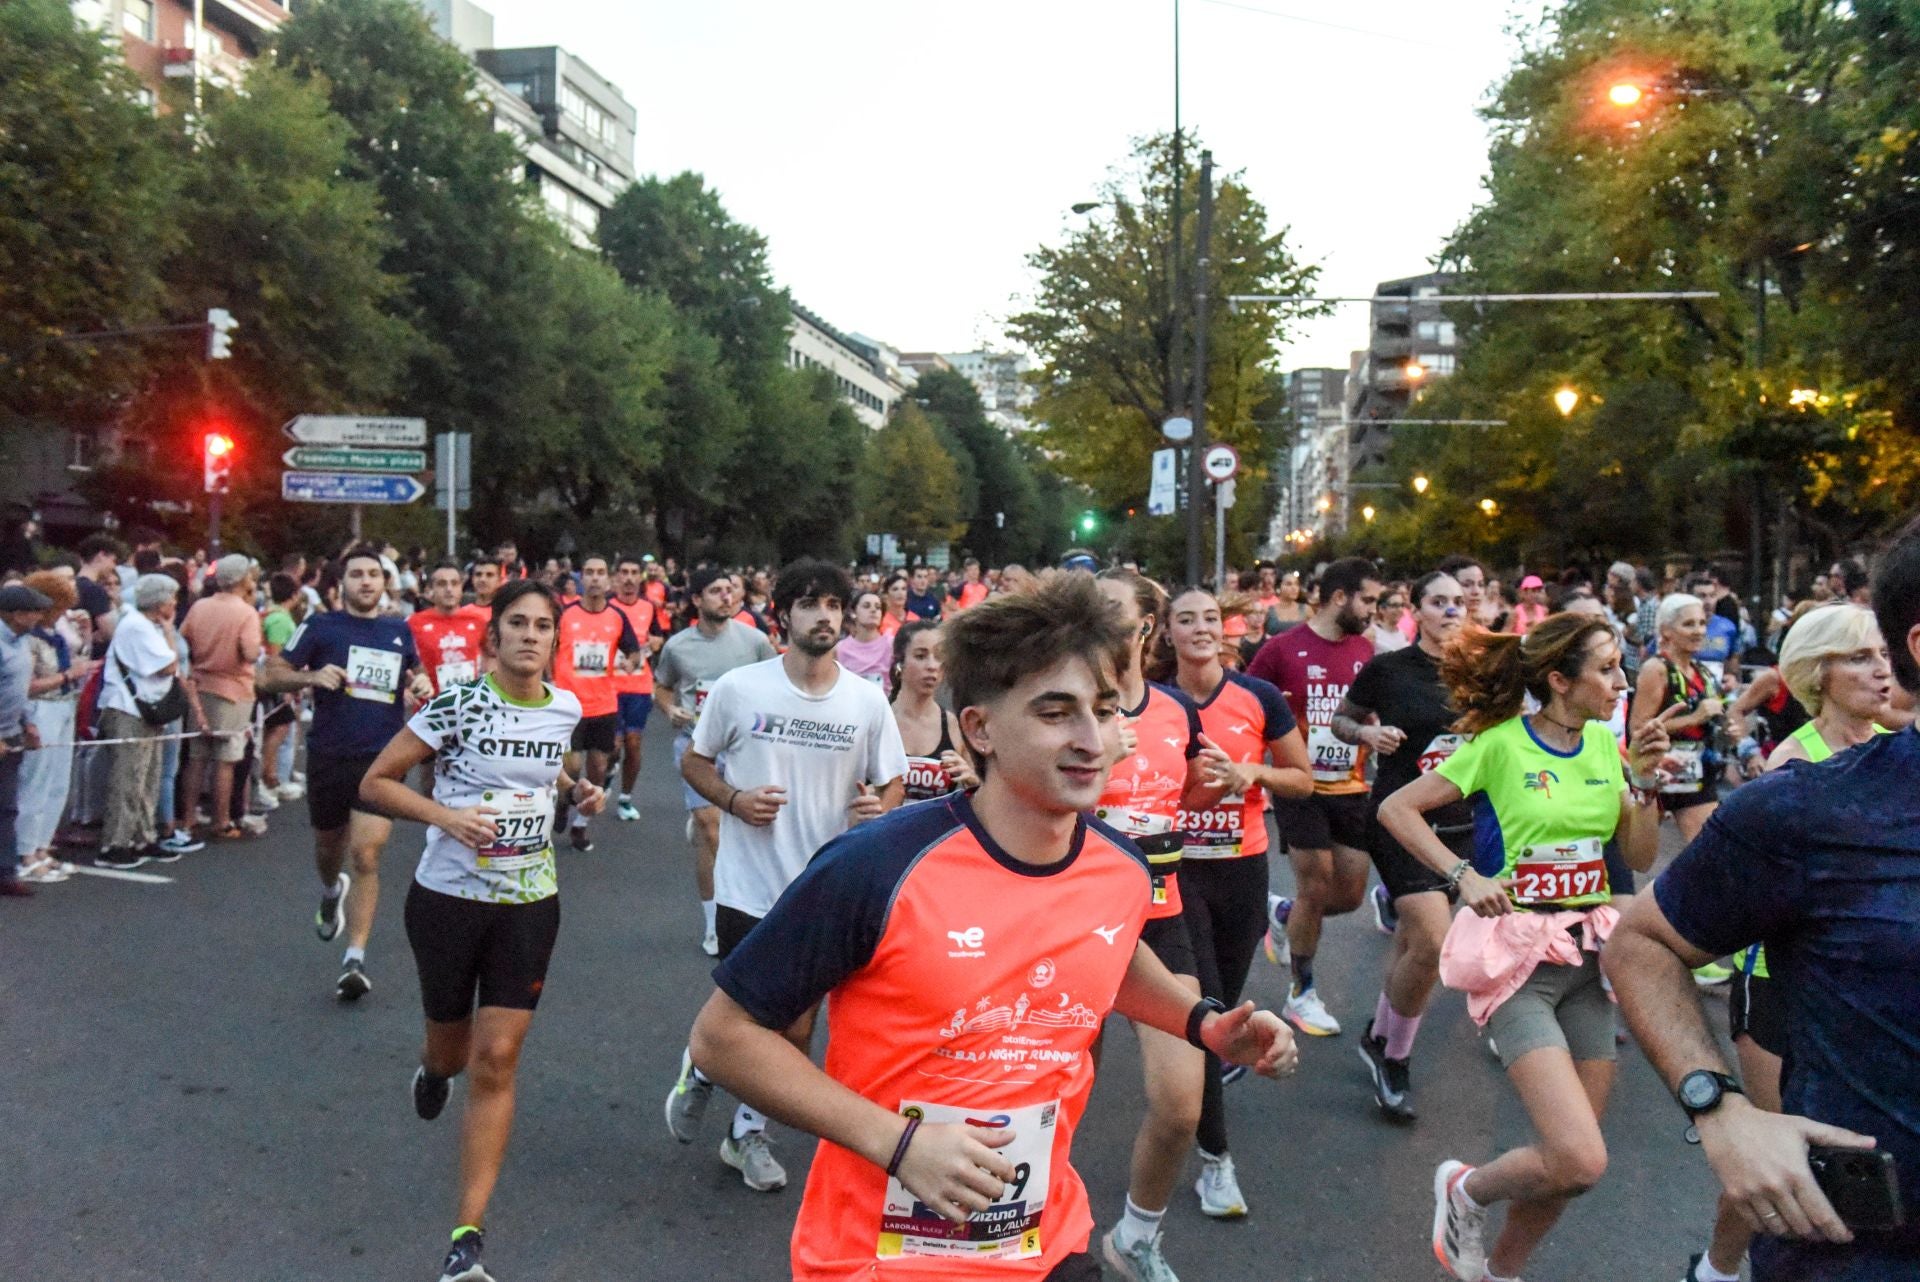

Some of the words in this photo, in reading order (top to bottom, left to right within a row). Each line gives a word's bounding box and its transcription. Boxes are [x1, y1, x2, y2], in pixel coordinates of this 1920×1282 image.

[356, 665, 391, 681] 7305
[1307, 684, 1323, 697] LA
[791, 718, 858, 735] REDVALLEY
[752, 733, 775, 743] Making
[777, 736, 787, 744] the
[788, 739, 808, 747] world
[814, 742, 833, 750] better
[786, 729, 855, 744] INTERNATIONAL
[1316, 745, 1351, 760] 7036
[495, 815, 546, 837] 5797
[1176, 810, 1240, 830] 23995
[1524, 870, 1601, 897] 23197
[988, 1049, 1028, 1062] NIGHT
[1012, 1162, 1031, 1200] 9
[884, 1222, 920, 1232] LABORAL
[987, 1223, 1002, 1233] LA
[1002, 1217, 1031, 1232] SALVE
[1027, 1236, 1035, 1248] 5
